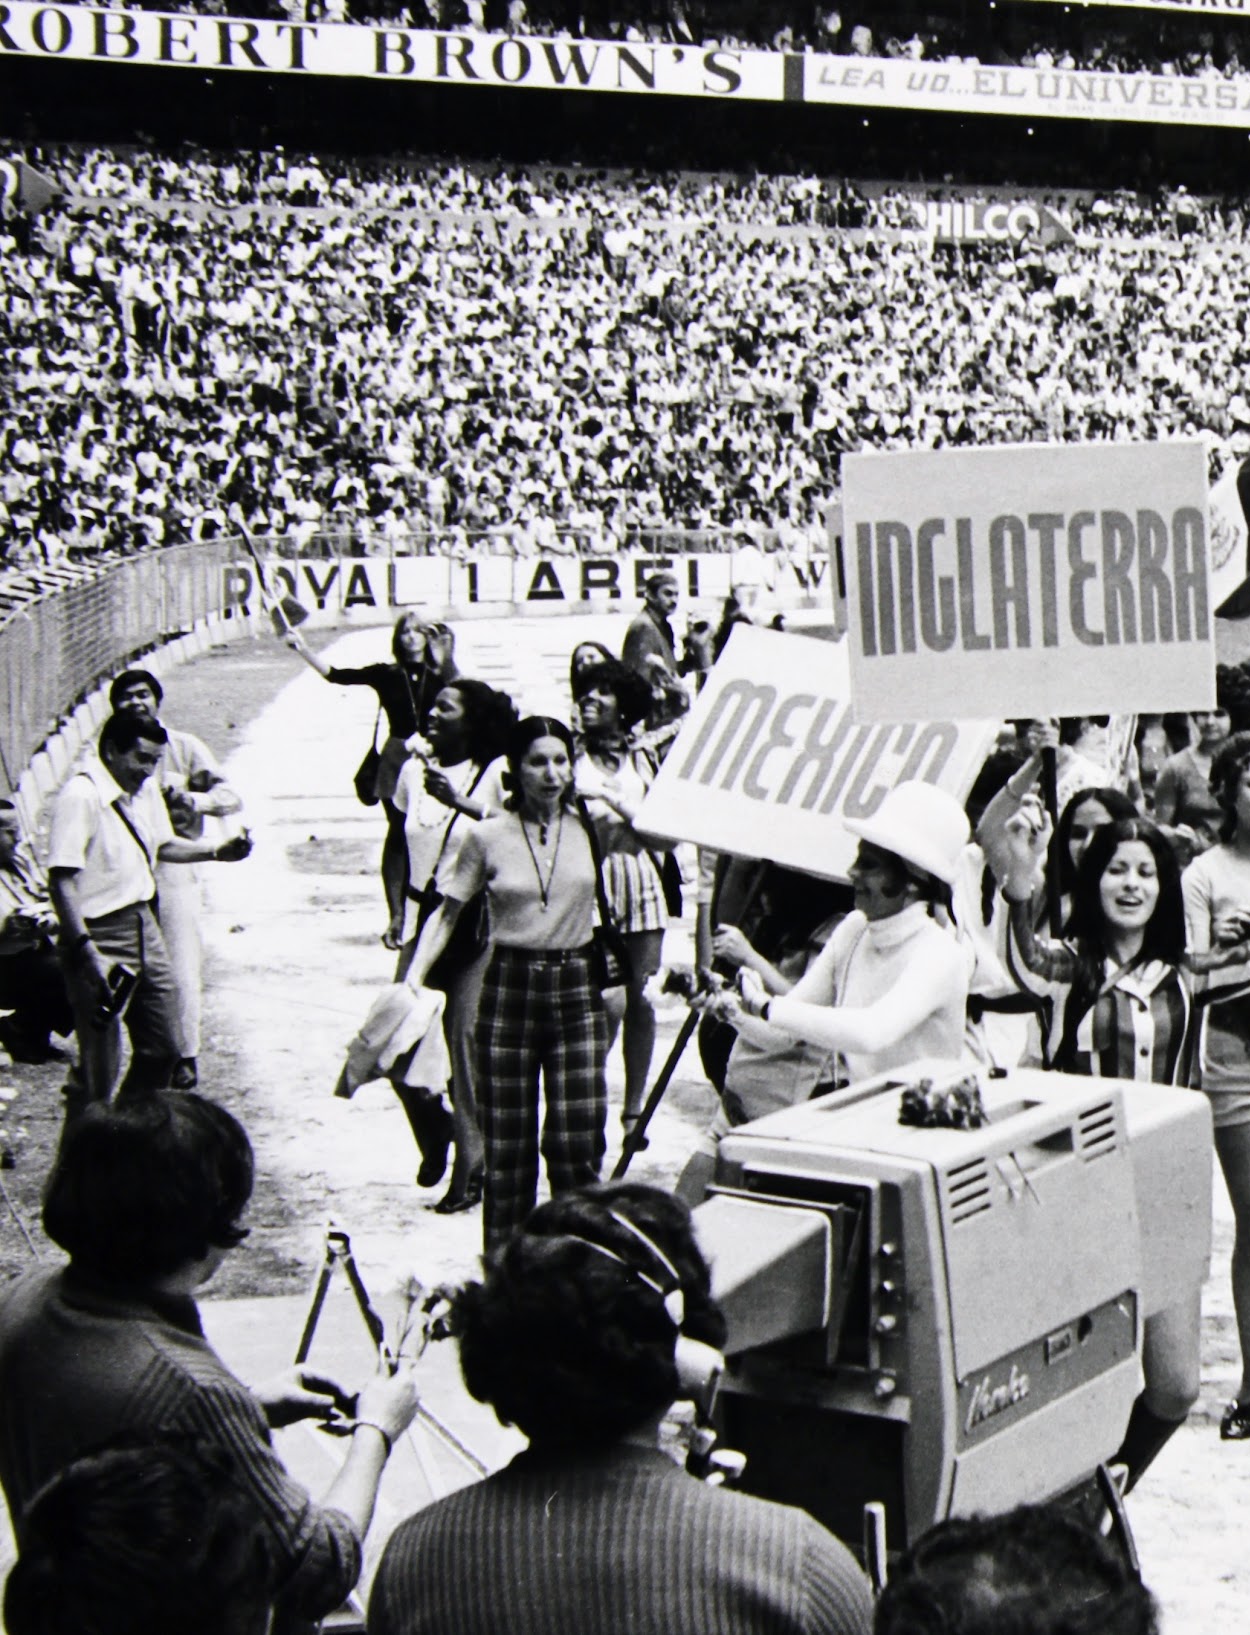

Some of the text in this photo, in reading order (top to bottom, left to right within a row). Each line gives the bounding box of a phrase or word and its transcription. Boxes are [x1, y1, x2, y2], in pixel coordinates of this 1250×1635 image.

[373, 31, 743, 94] BROWN'S
[818, 65, 886, 89] LEA
[973, 69, 1027, 97] EL
[854, 506, 1210, 657] INGLATERRA
